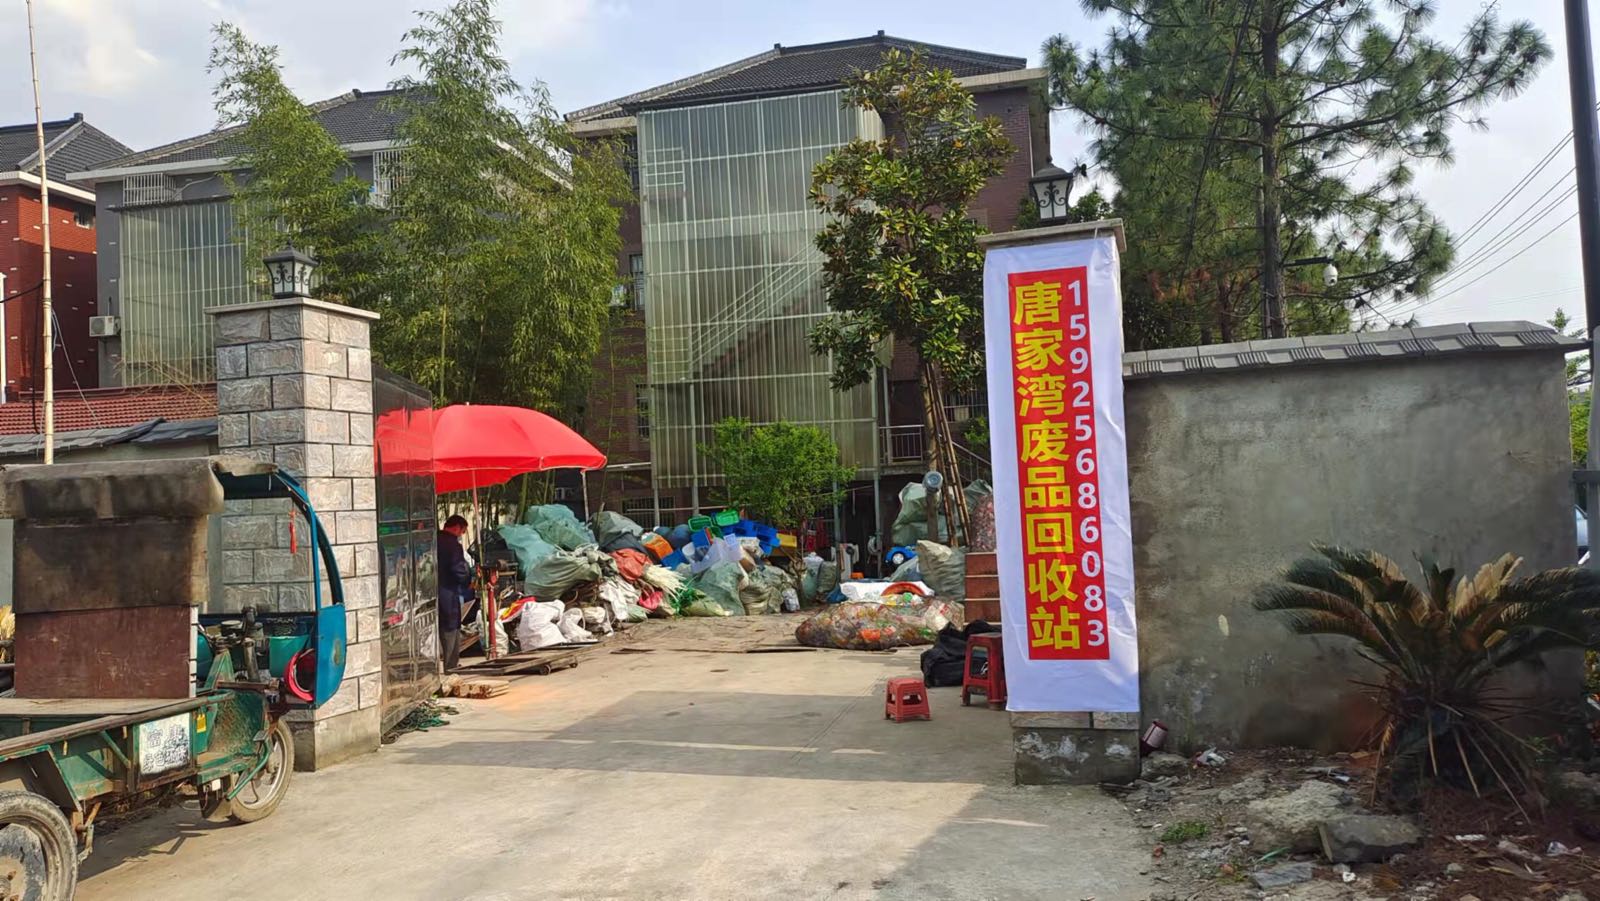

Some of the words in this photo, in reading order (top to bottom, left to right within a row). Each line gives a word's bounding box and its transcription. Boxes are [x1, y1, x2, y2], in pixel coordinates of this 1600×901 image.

[1013, 281, 1080, 649] 唐家湾废品回收站
[1067, 280, 1105, 647] 15925686083
